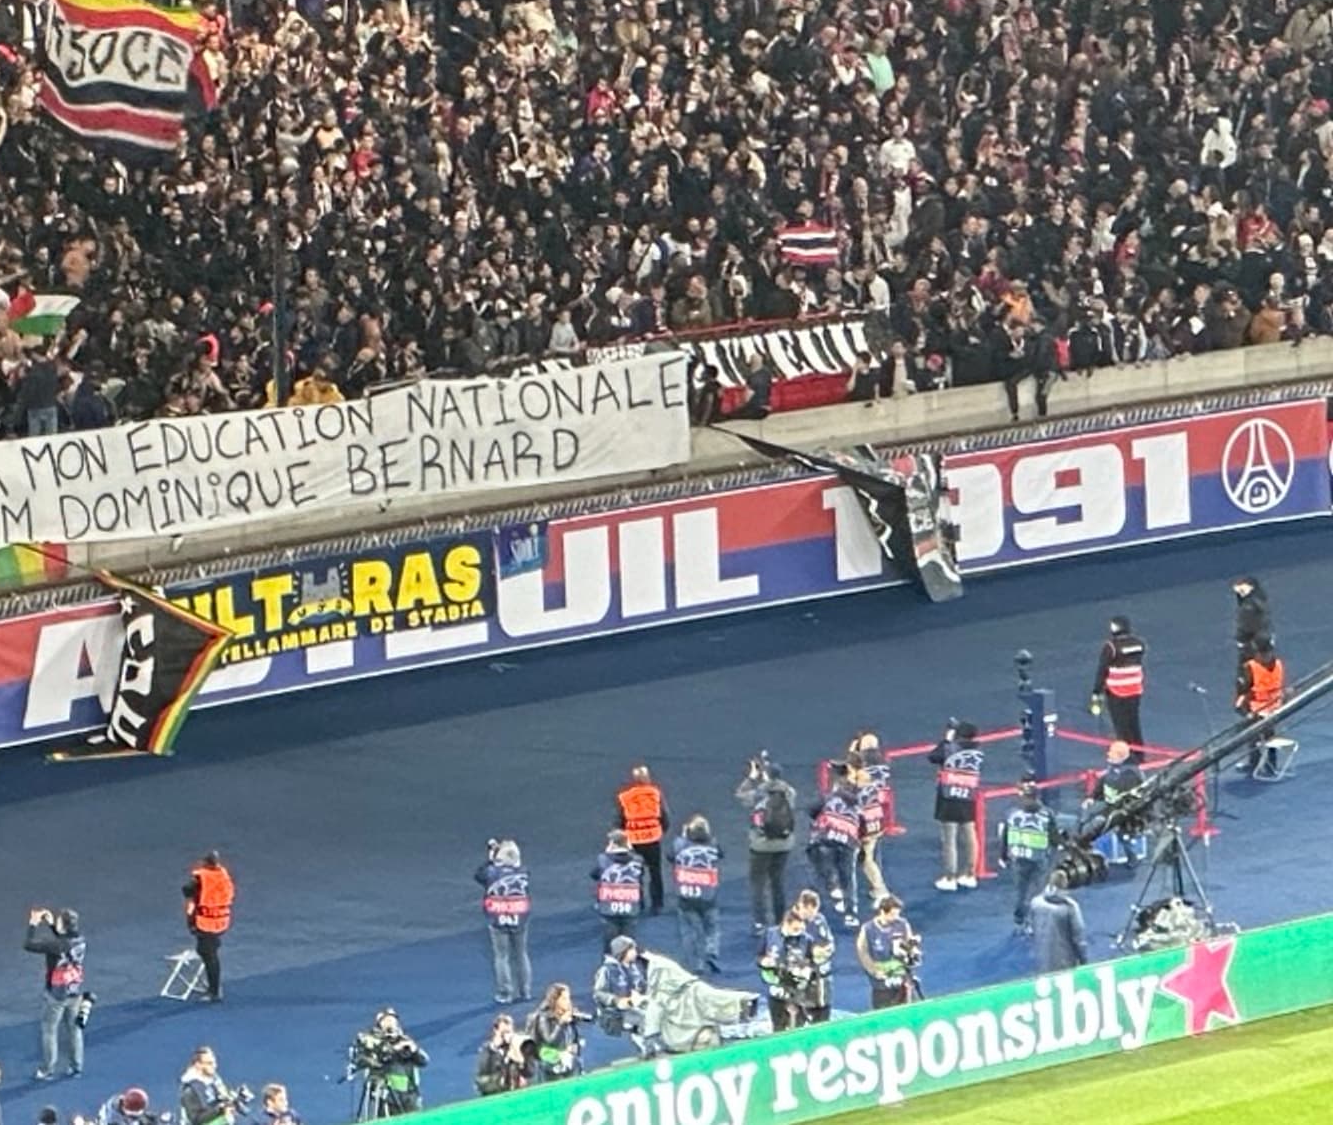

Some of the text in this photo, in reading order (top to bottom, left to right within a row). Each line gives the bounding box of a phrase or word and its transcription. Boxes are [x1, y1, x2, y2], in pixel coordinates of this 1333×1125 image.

[2, 497, 33, 543] M
[347, 427, 581, 496] BERNARD
[22, 435, 107, 491] MON
[370, 616, 395, 633] DI
[408, 601, 485, 628] STABIA
[566, 966, 1162, 1125] enjoy responsibly
